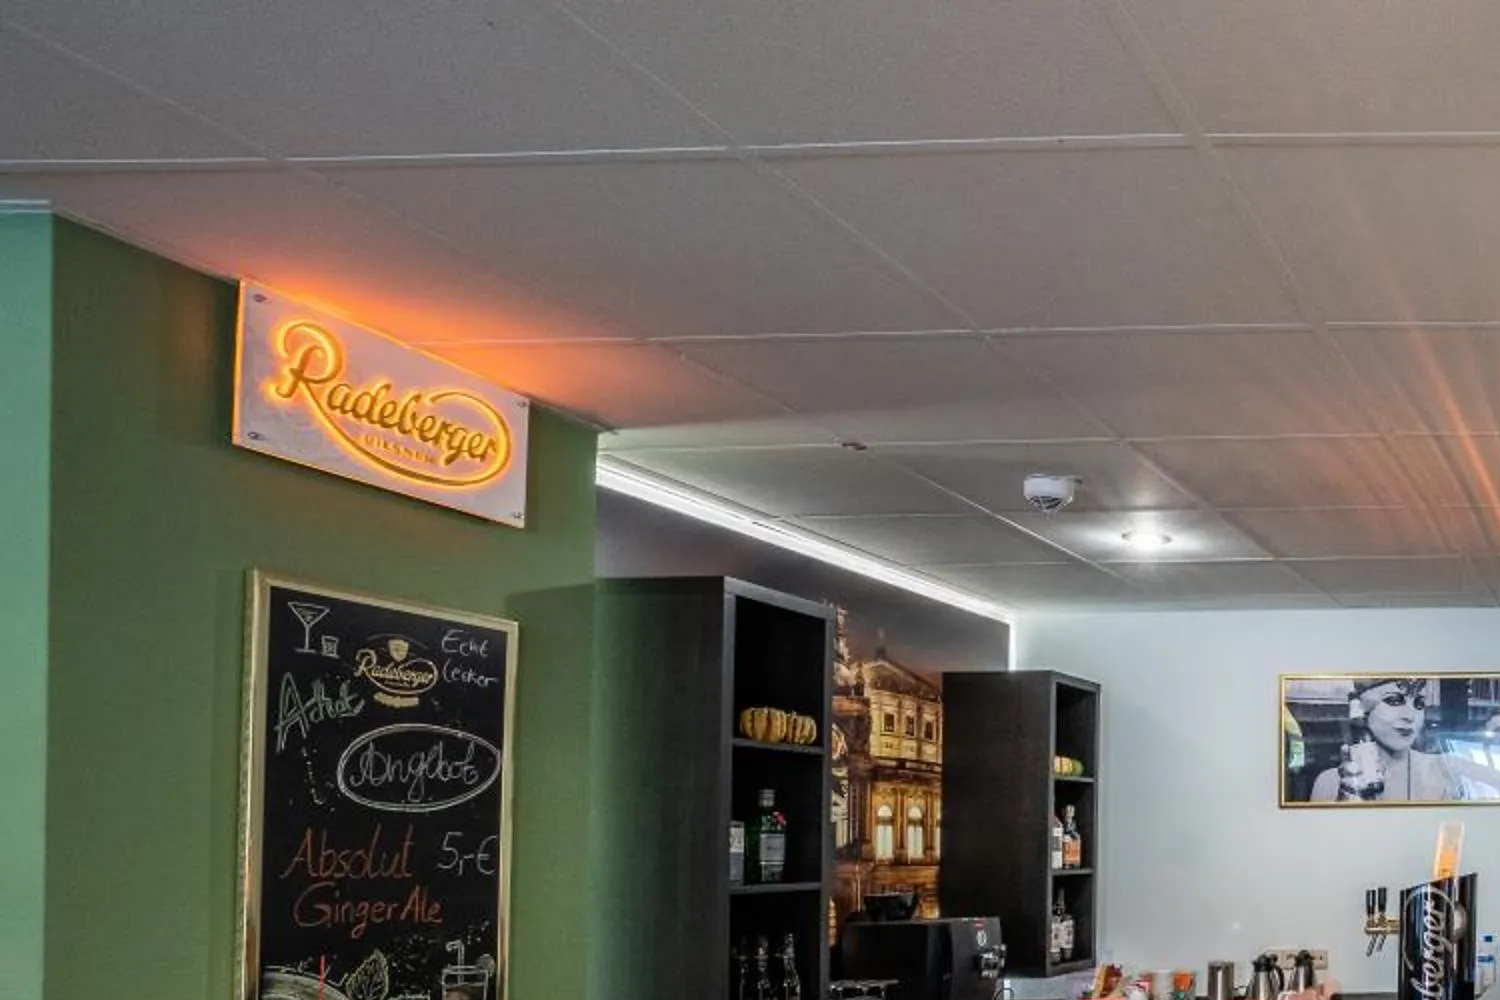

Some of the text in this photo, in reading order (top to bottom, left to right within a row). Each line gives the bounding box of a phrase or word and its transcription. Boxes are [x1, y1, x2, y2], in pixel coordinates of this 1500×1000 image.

[269, 318, 500, 468] Radeberger
[353, 648, 434, 688] Radeberger
[279, 823, 415, 879] Absolut
[293, 881, 443, 940] Ginger Ale
